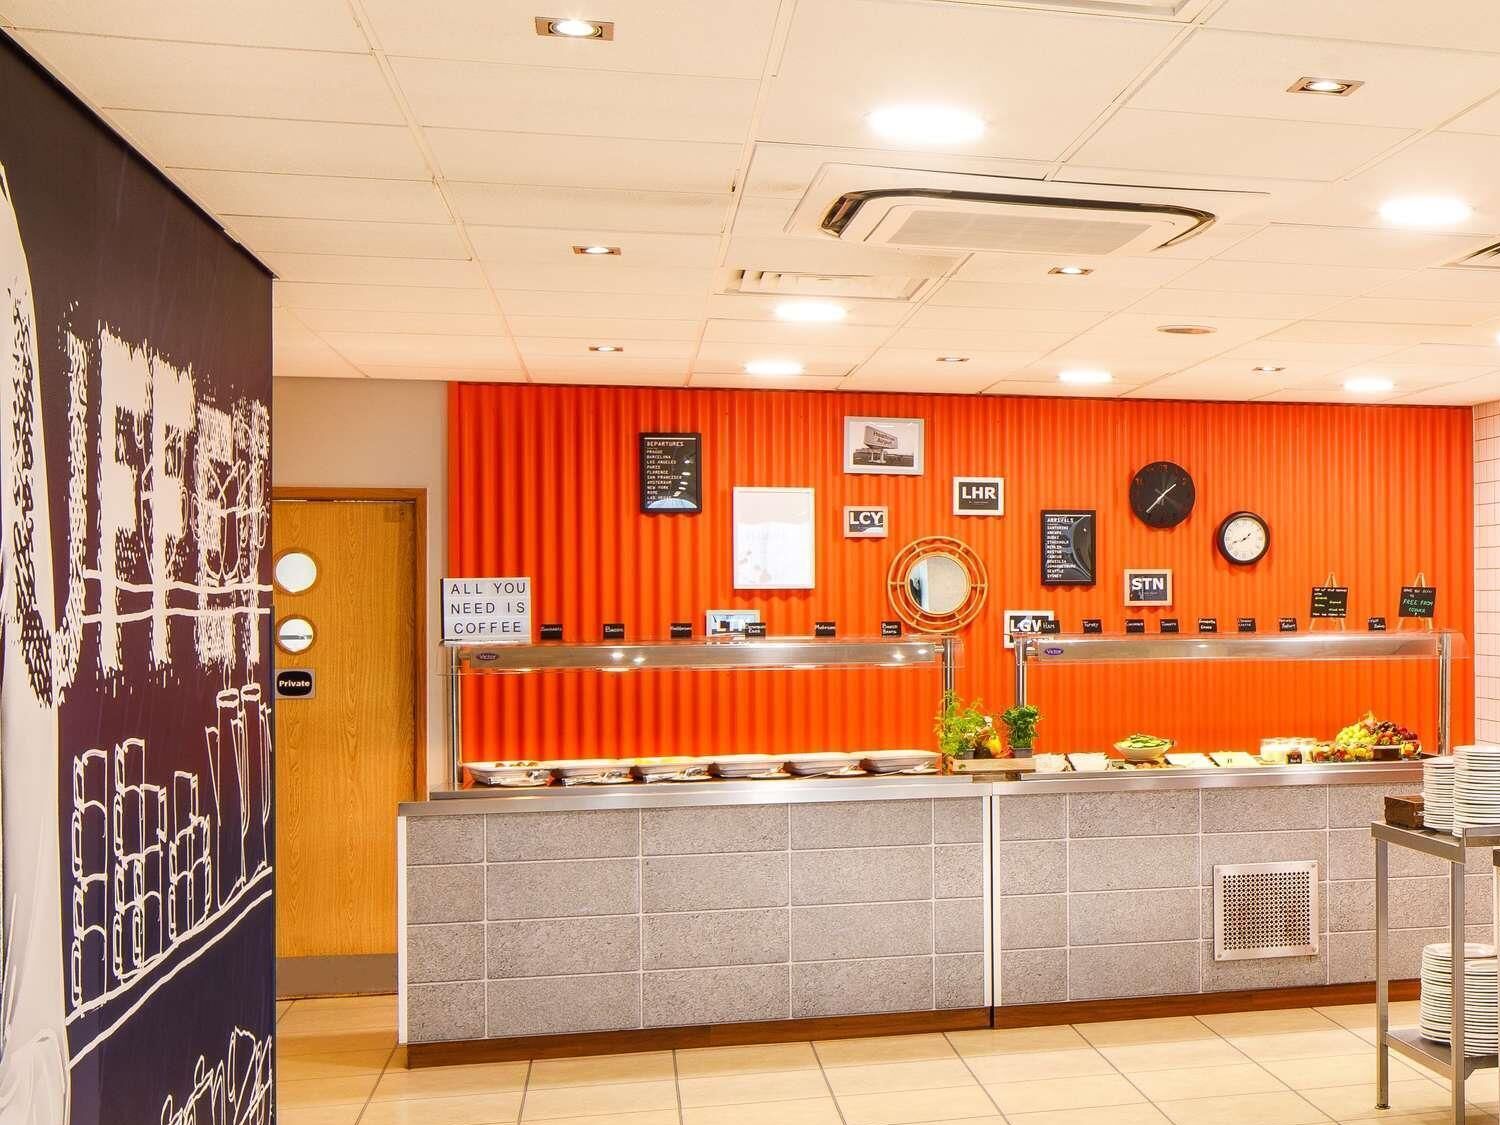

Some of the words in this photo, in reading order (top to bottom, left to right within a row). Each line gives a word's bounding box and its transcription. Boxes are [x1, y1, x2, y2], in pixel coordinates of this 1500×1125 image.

[962, 486, 996, 499] LHR
[850, 512, 882, 524] LCY
[451, 583, 482, 594] ALL
[494, 582, 526, 594] YOU
[1131, 578, 1164, 590] STN
[451, 602, 495, 614] NEED
[507, 602, 525, 613] IS
[454, 622, 521, 634] COFFEE
